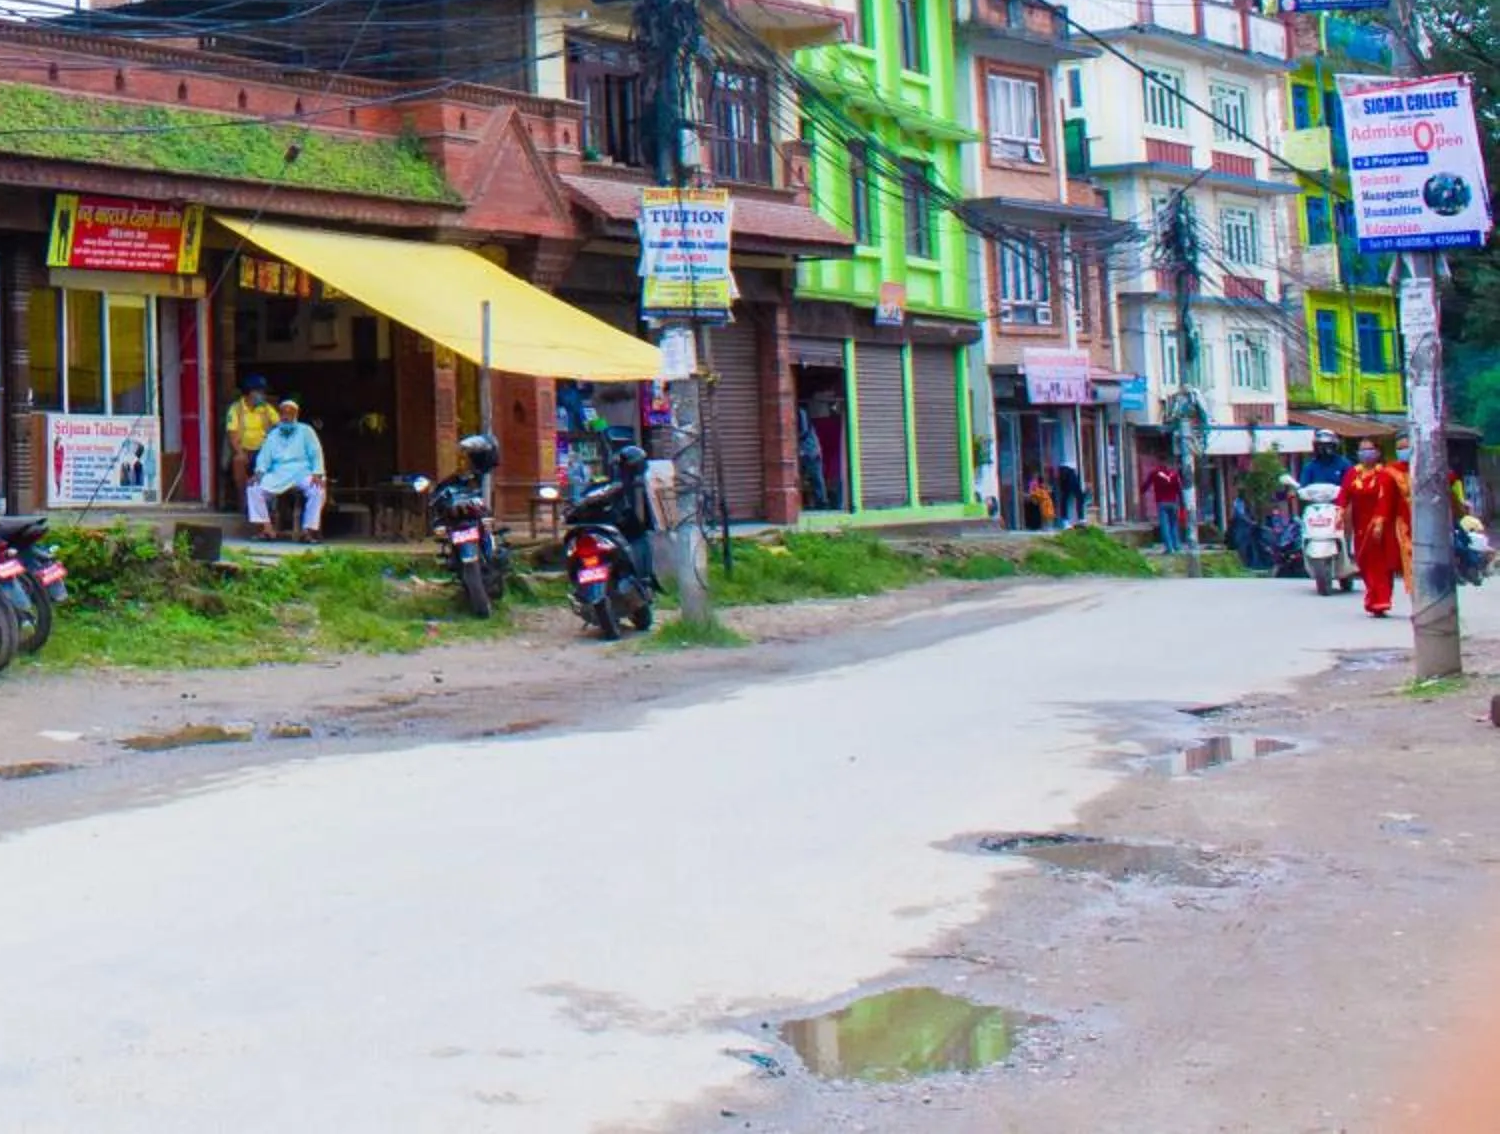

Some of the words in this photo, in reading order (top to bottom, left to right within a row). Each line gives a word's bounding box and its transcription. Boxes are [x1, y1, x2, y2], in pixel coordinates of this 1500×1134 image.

[1363, 95, 1405, 115] SIGMA
[1406, 91, 1460, 112] COLLEGE
[1361, 188, 1420, 203] Management
[650, 209, 725, 224] TUITION
[1363, 204, 1424, 217] Humanities
